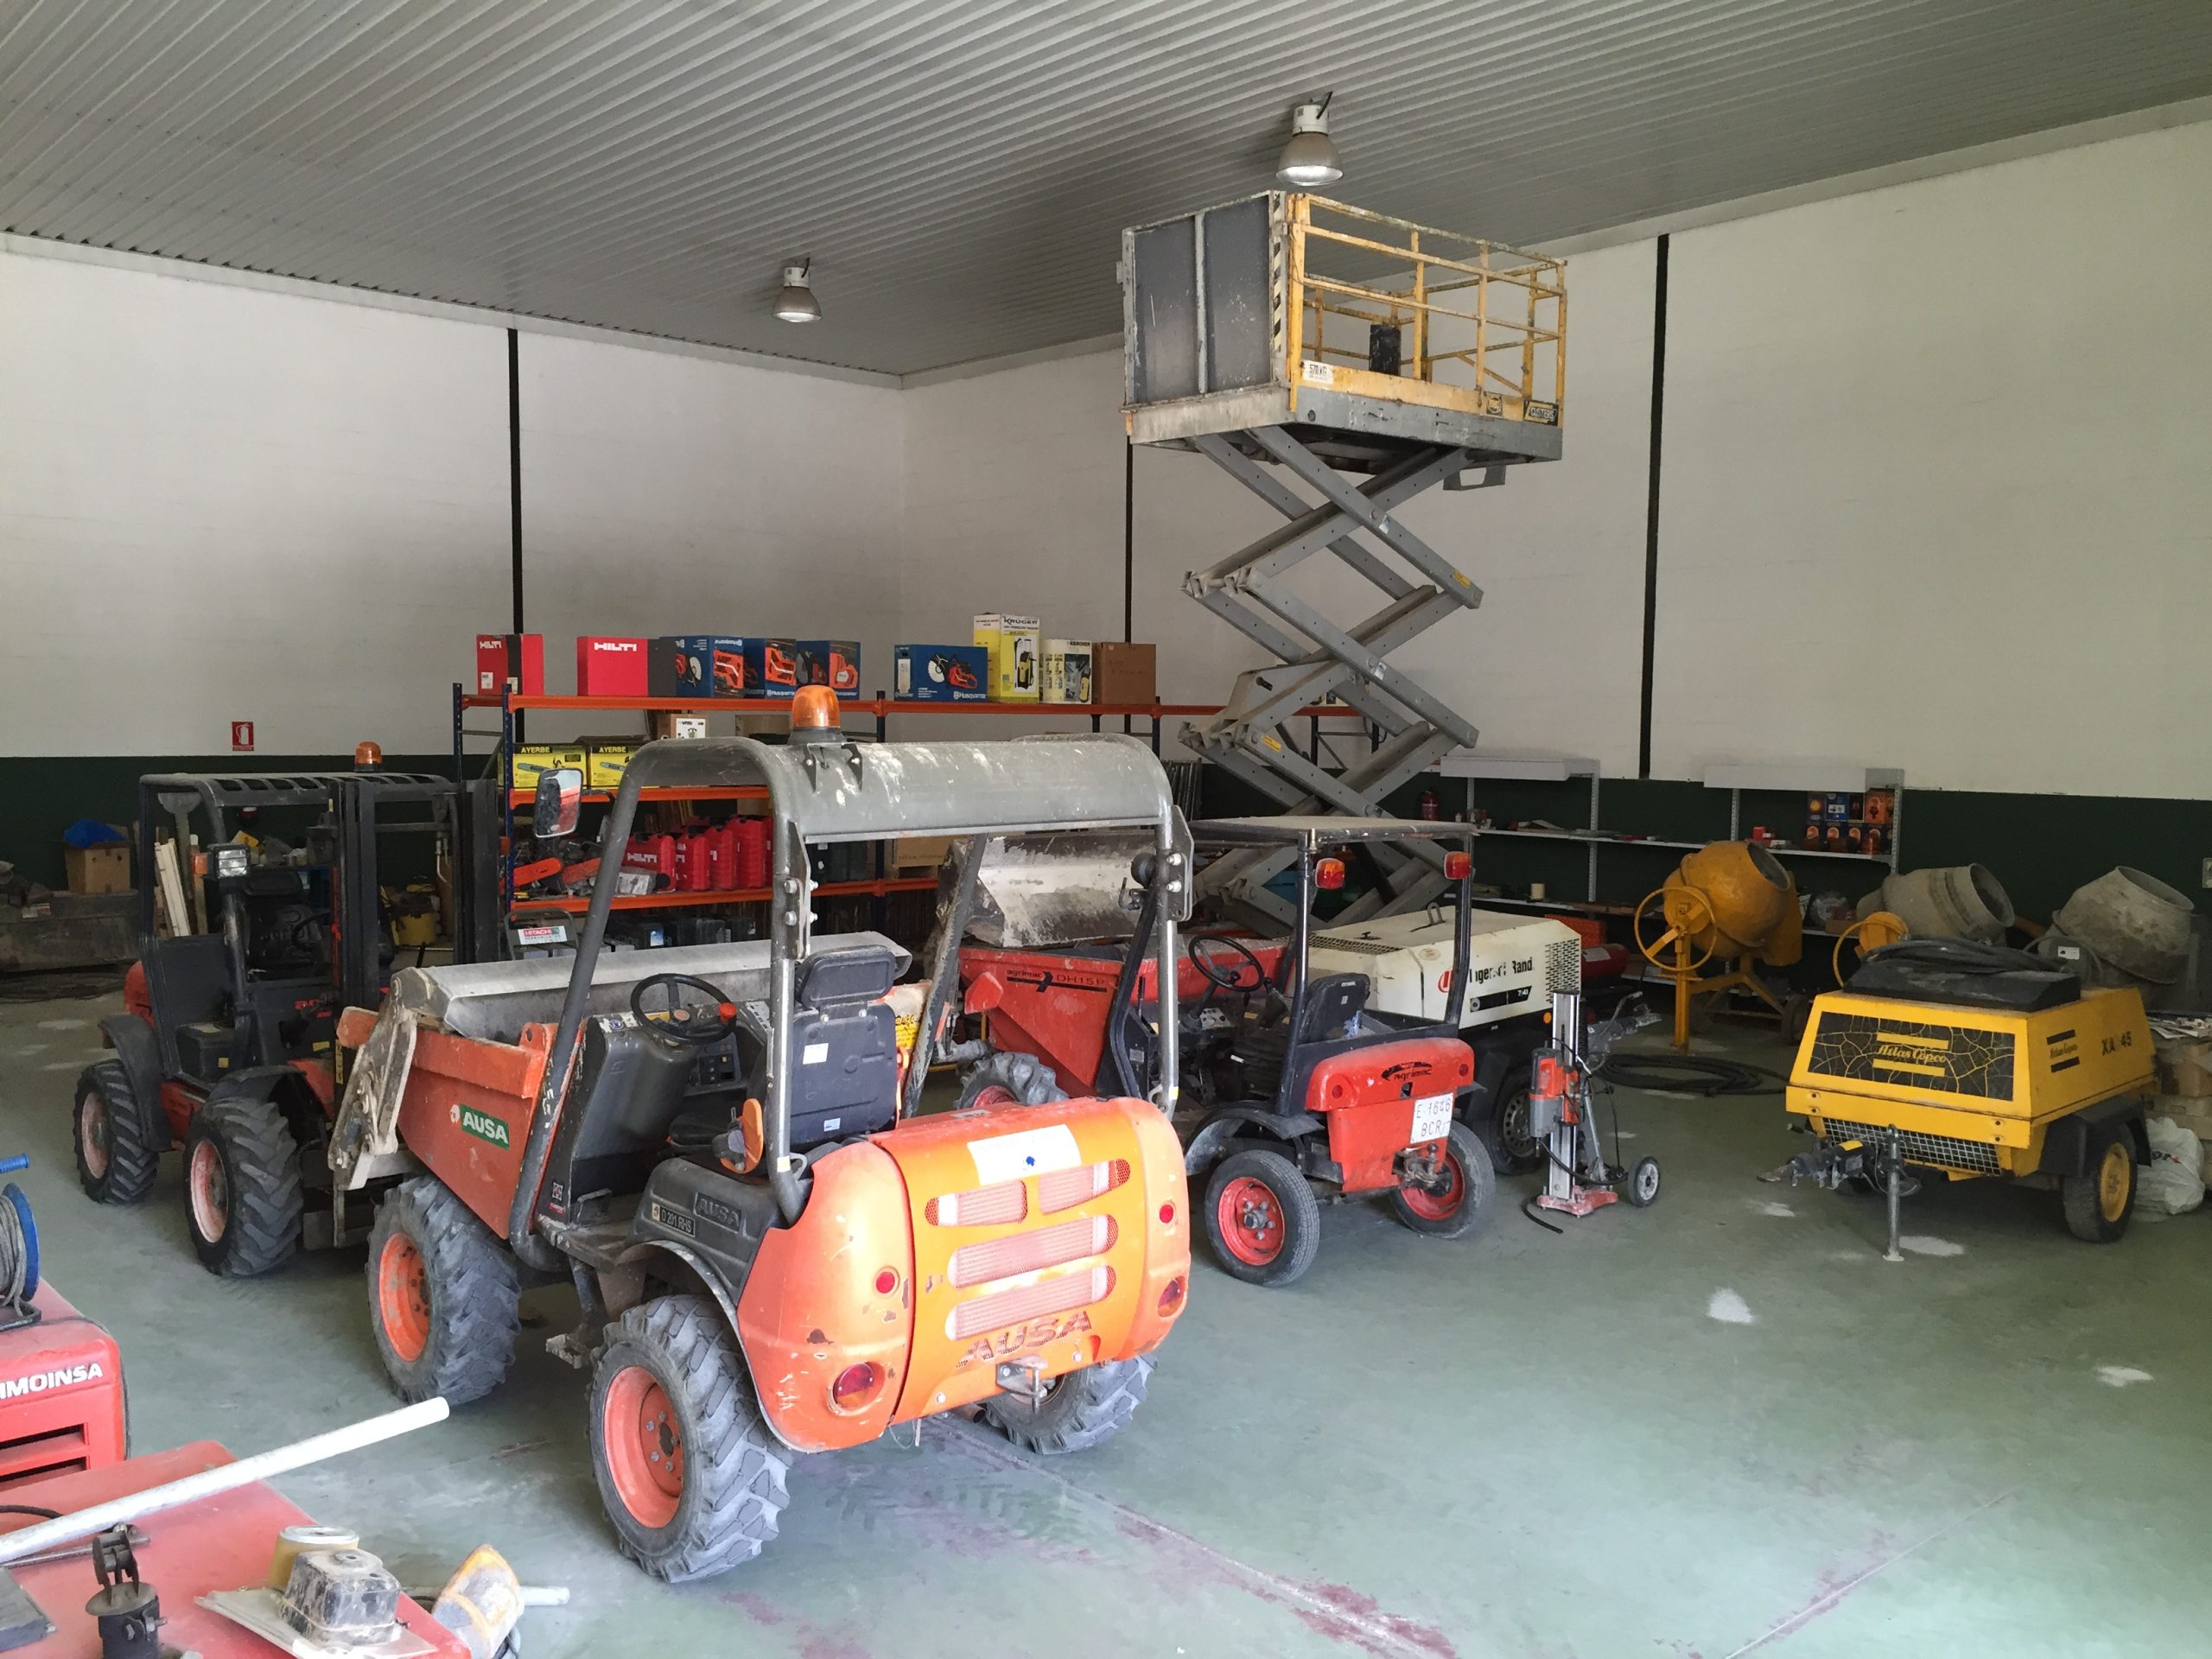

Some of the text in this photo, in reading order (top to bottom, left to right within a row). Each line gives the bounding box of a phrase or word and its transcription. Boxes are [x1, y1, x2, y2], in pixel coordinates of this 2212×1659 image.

[480, 640, 502, 649] HILTI
[594, 642, 637, 652] HILTI
[1512, 957, 1533, 974] Rand
[2121, 1031, 2132, 1047] 45
[1878, 1045, 1947, 1065] Atlas Copco
[462, 1111, 509, 1144] AUSA
[667, 1211, 677, 1227] 201
[678, 1217, 692, 1233] RHS
[697, 1198, 740, 1228] AUSA
[956, 1311, 1092, 1368] AUSA
